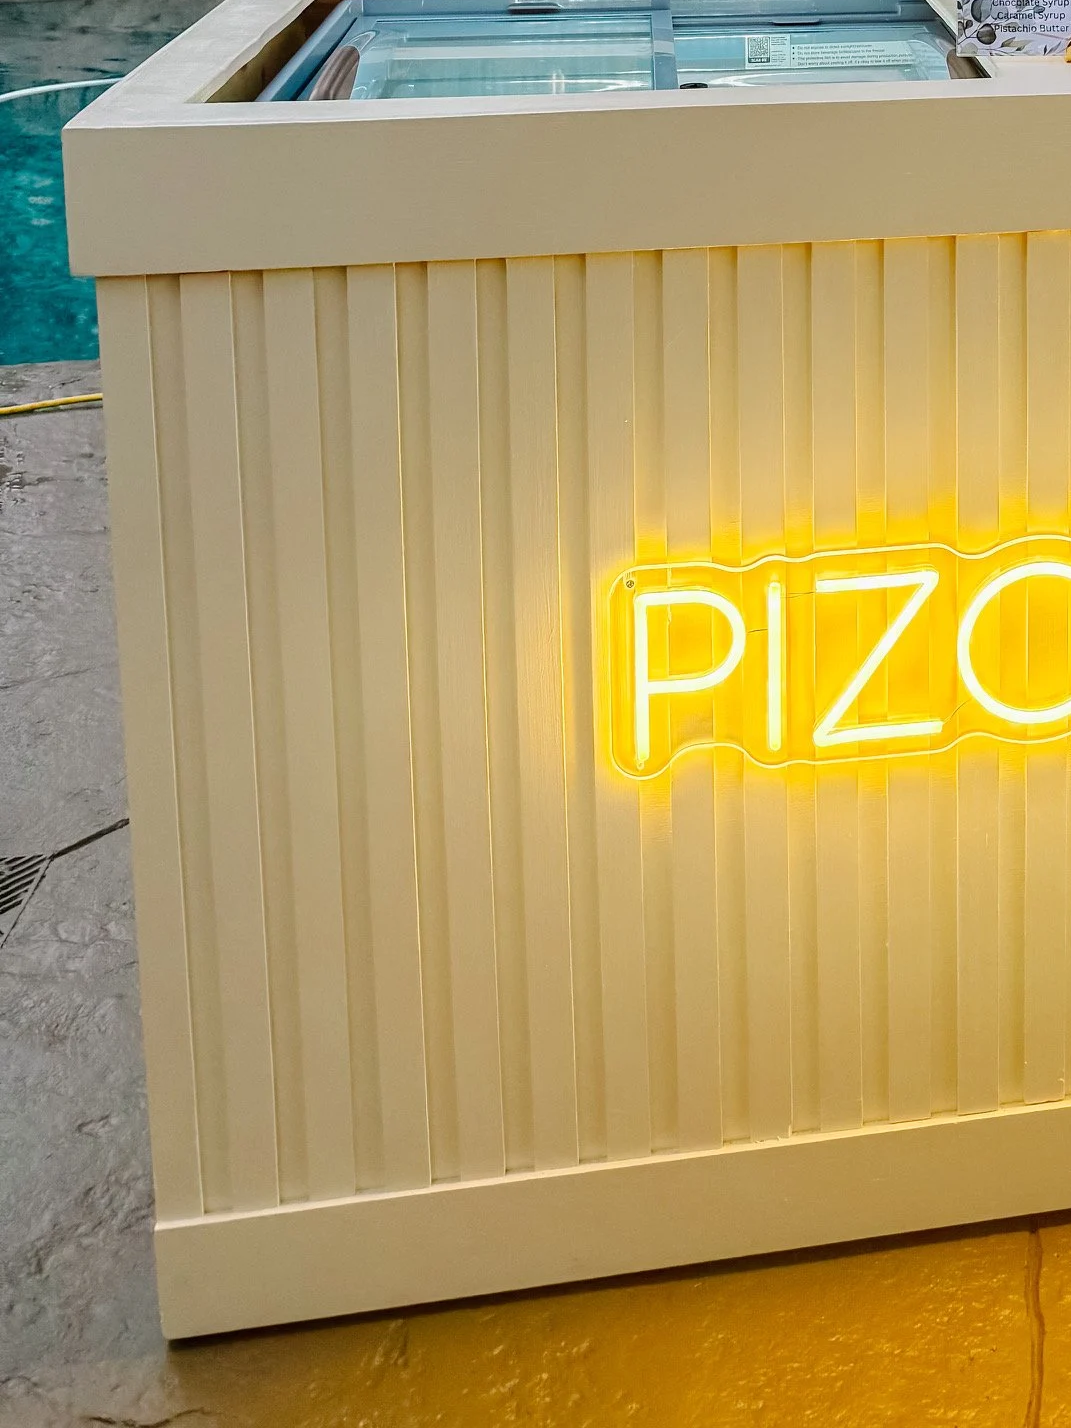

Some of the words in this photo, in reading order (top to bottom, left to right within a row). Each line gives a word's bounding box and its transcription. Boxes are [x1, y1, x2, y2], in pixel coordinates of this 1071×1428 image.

[997, 11, 1036, 20] Caramel
[1038, 12, 1066, 21] Syrup
[994, 24, 1037, 33] Pistachio
[1039, 24, 1070, 33] Butter
